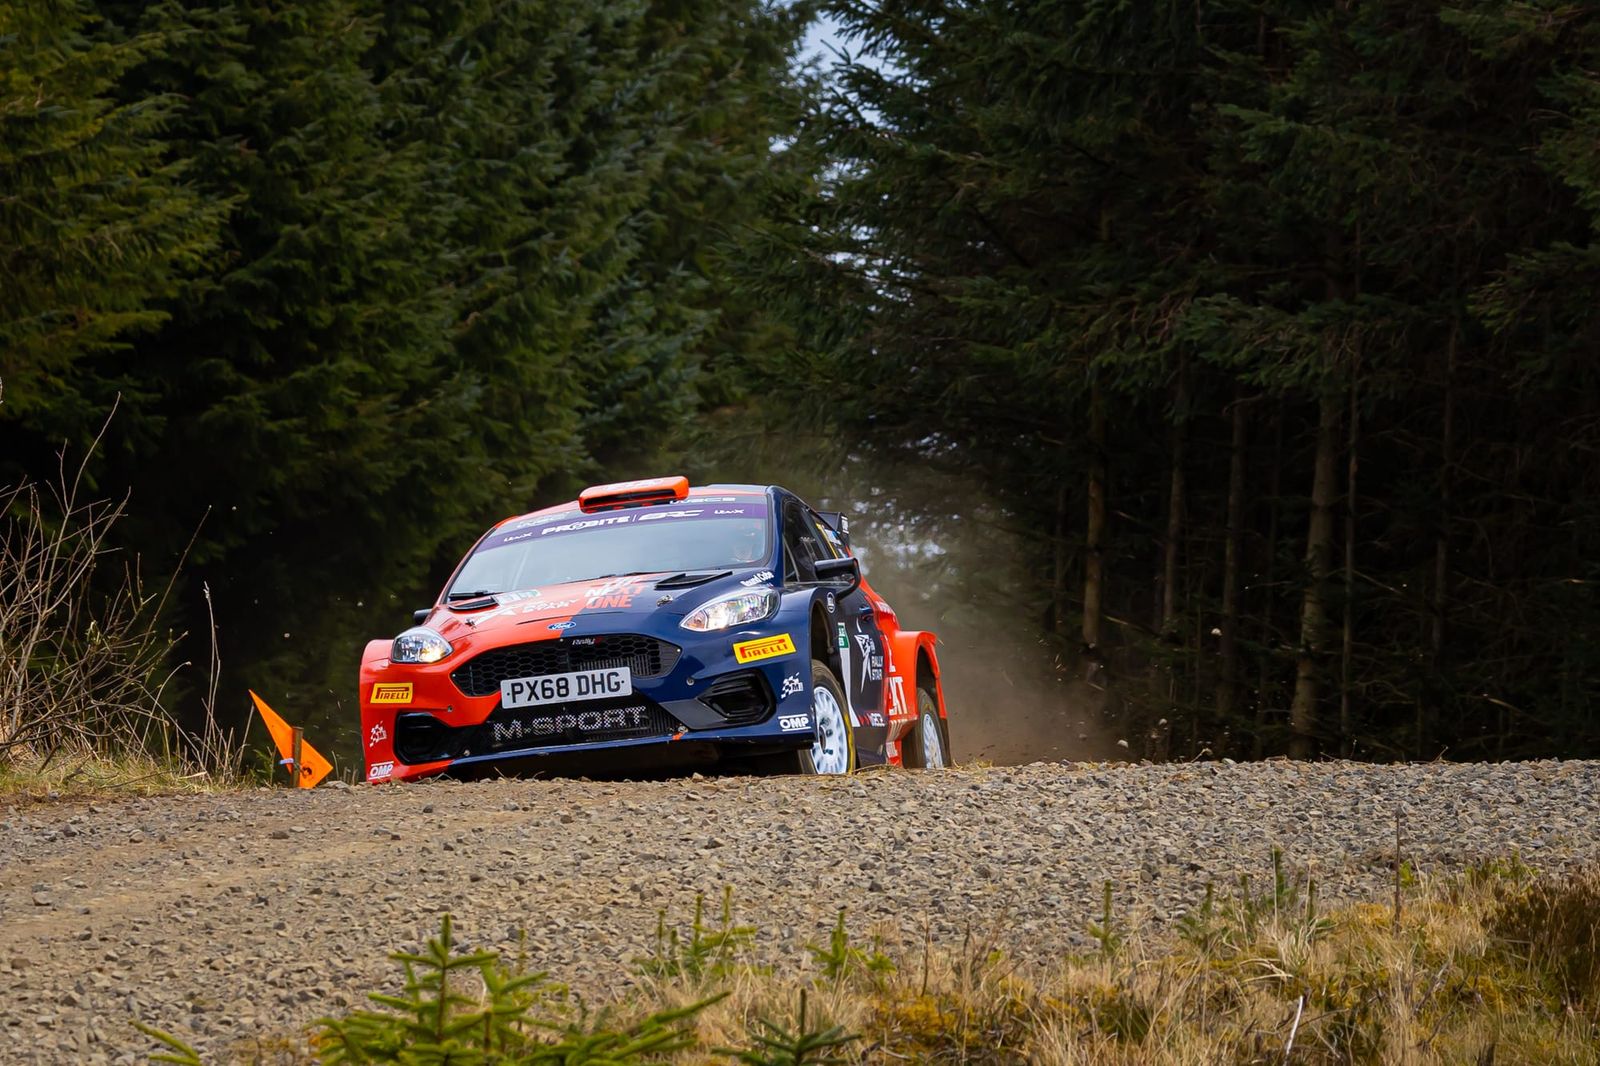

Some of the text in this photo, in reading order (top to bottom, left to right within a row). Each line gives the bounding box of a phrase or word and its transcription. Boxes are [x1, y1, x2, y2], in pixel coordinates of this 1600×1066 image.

[585, 595, 633, 609] ONE
[739, 638, 788, 659] PIRELLI
[375, 686, 410, 700] PIRELLI
[510, 671, 621, 704] PX68 DHG
[492, 705, 647, 741] M-SPORT
[780, 717, 809, 730] OMP
[369, 763, 394, 778] OMP
